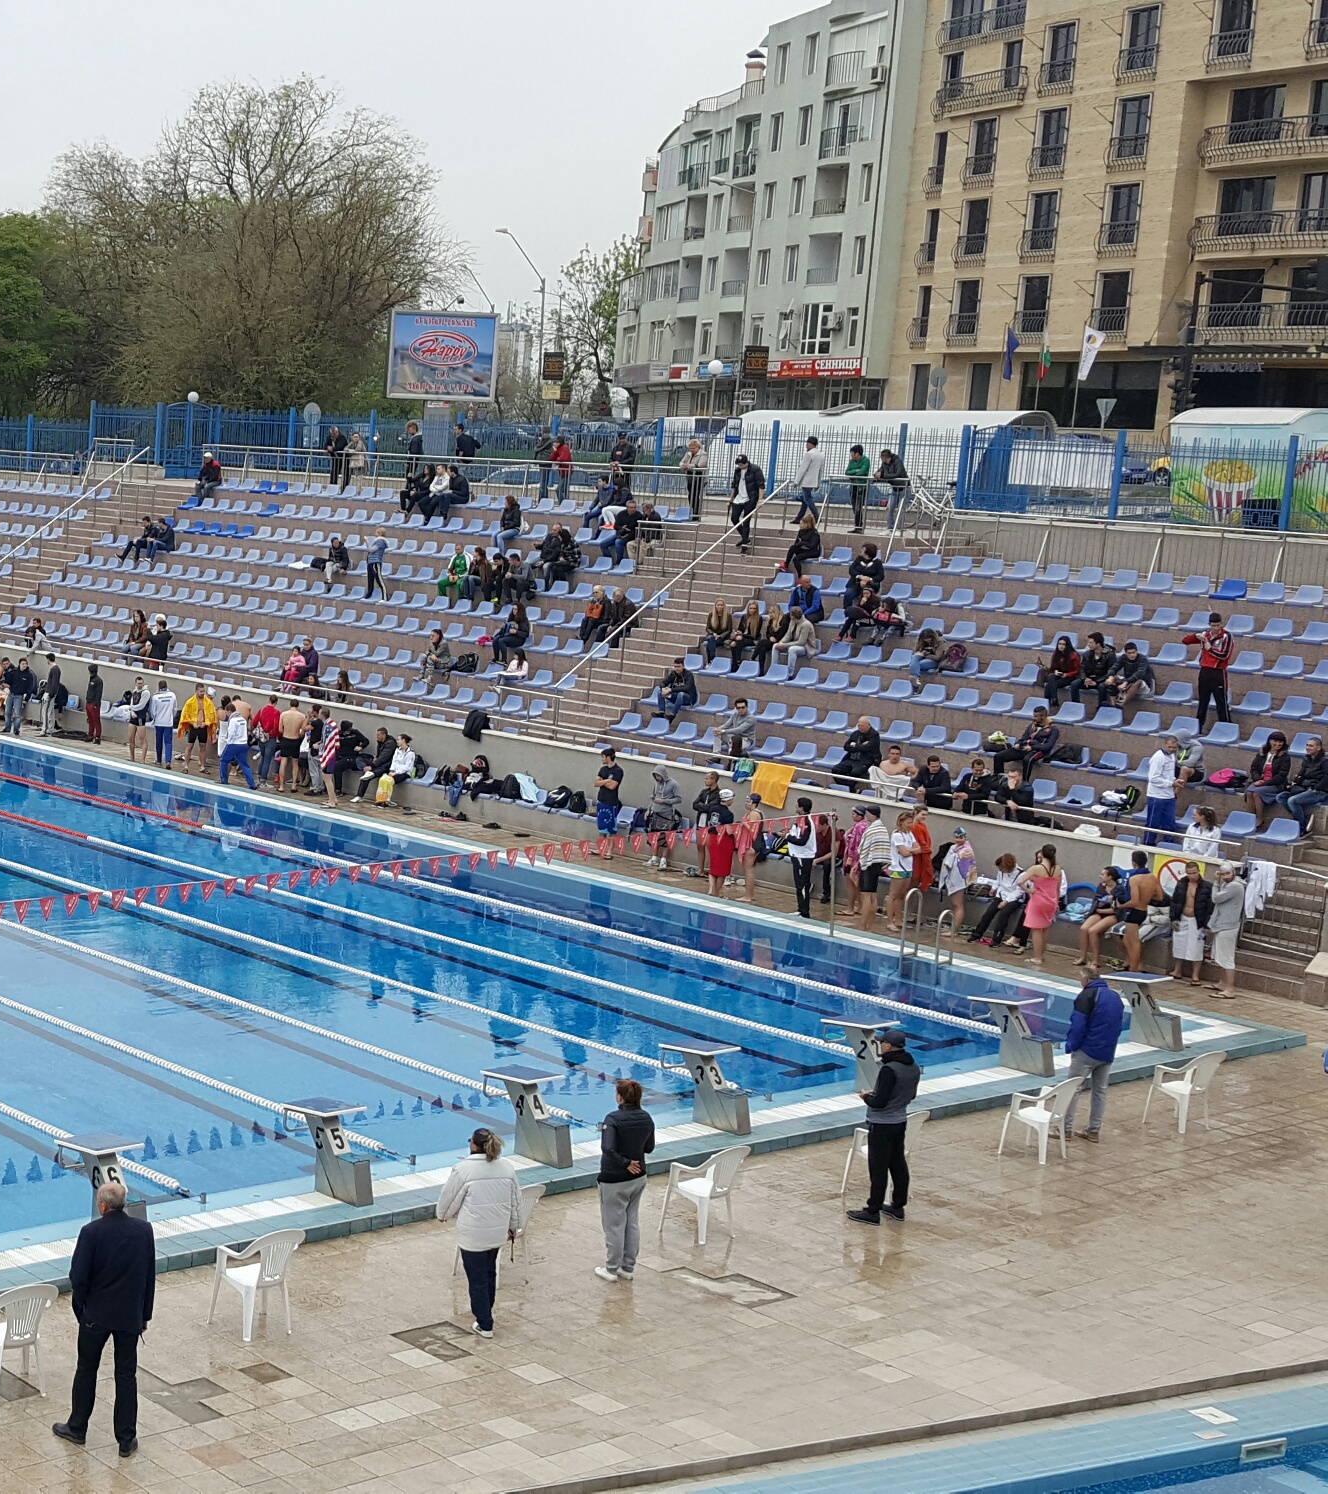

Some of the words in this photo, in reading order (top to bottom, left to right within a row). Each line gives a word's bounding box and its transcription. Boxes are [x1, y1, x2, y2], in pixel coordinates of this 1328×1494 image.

[418, 337, 470, 362] Happy
[814, 358, 861, 370] СЕННИЦИ
[1015, 1015, 1026, 1033] 1
[857, 1040, 868, 1060] 2
[709, 1065, 722, 1085] 3
[532, 1094, 545, 1115] 4
[329, 1127, 345, 1150] 5
[106, 1166, 121, 1185] 6
